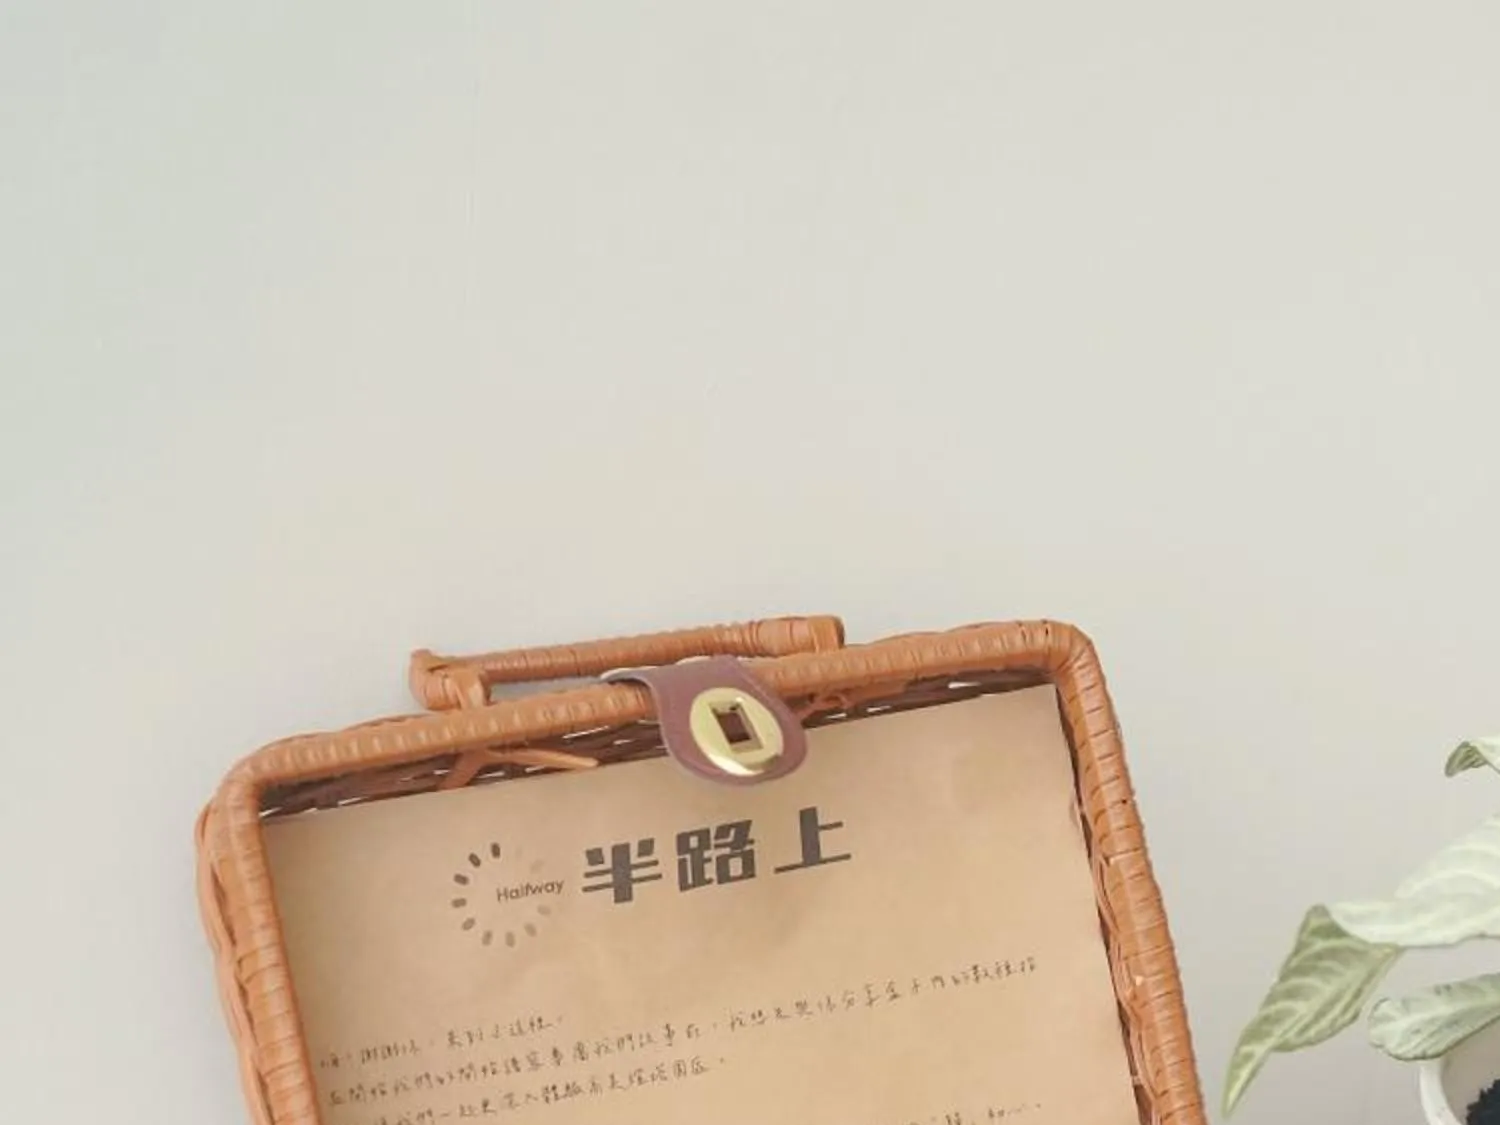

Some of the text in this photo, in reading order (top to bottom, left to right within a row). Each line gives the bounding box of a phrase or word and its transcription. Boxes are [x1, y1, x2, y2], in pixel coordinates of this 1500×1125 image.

[582, 806, 851, 904] 半路上
[496, 880, 564, 903] Halfway
